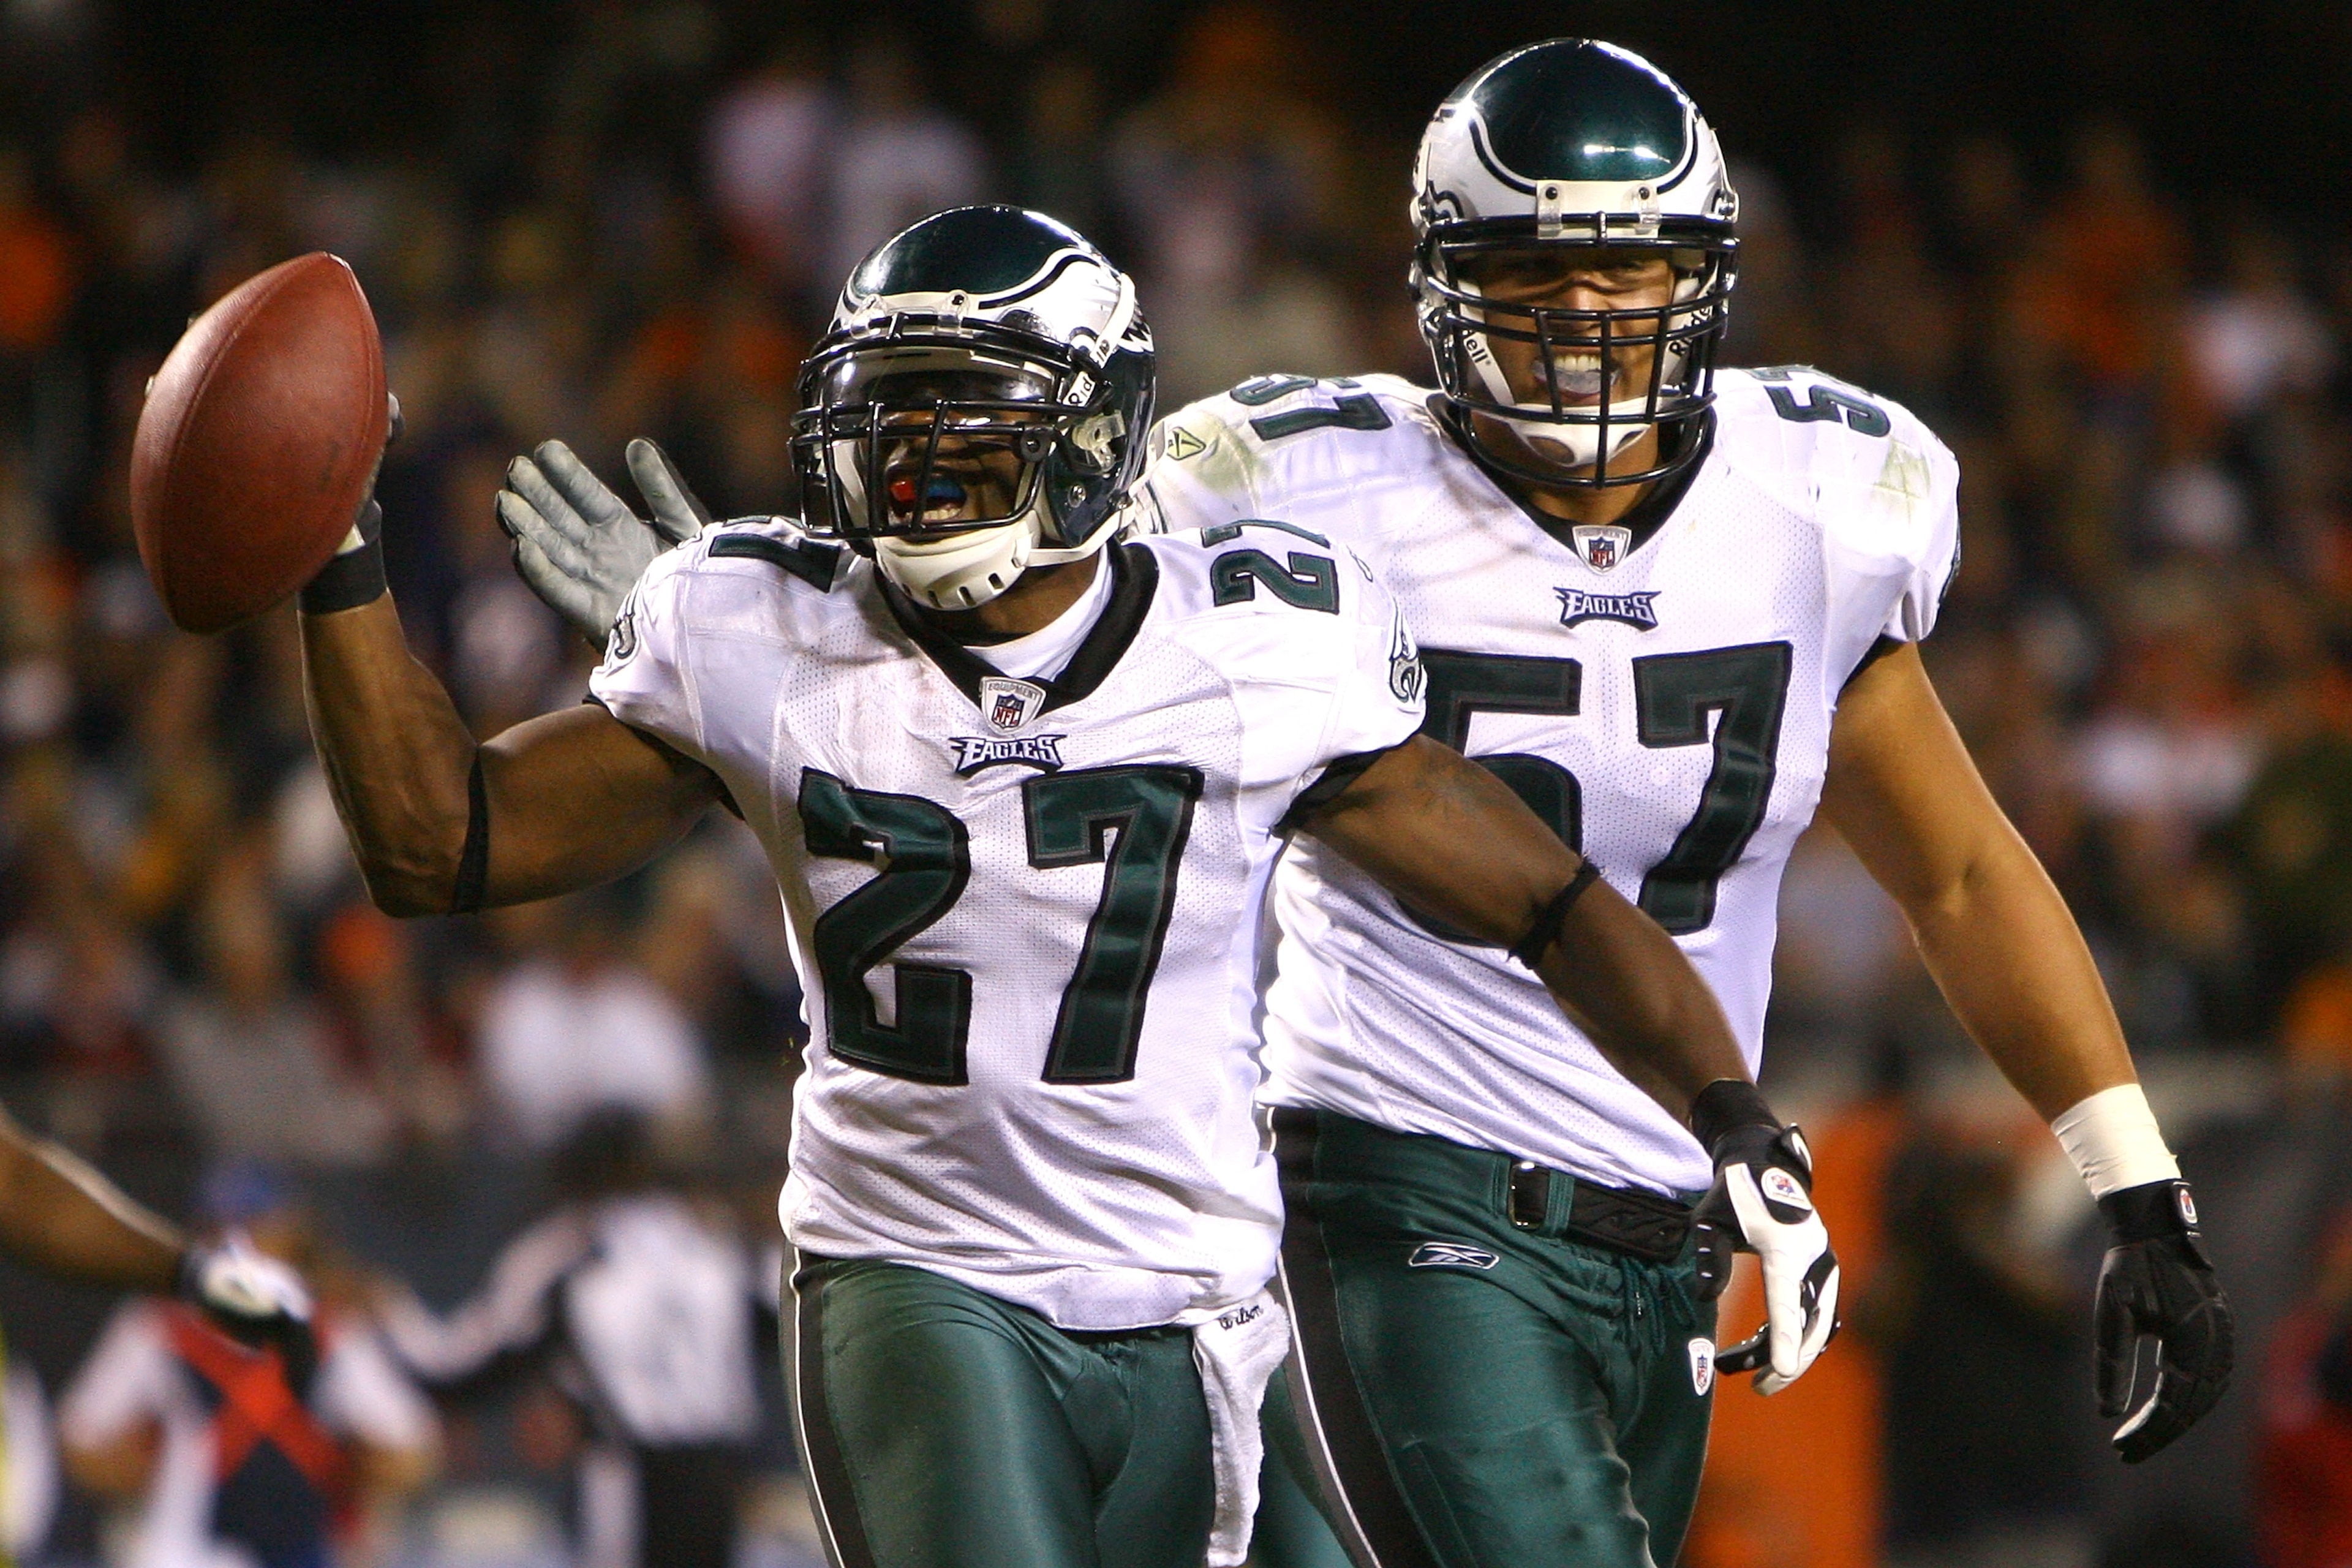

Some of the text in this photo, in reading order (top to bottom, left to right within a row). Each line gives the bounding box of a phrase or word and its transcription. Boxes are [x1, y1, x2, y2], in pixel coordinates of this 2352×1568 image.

[1553, 586, 1662, 631] EAGLES
[992, 706, 1020, 727] NFL
[948, 734, 1068, 777] EAGLES
[1396, 640, 1793, 948] 57
[798, 764, 1205, 1086] 27
